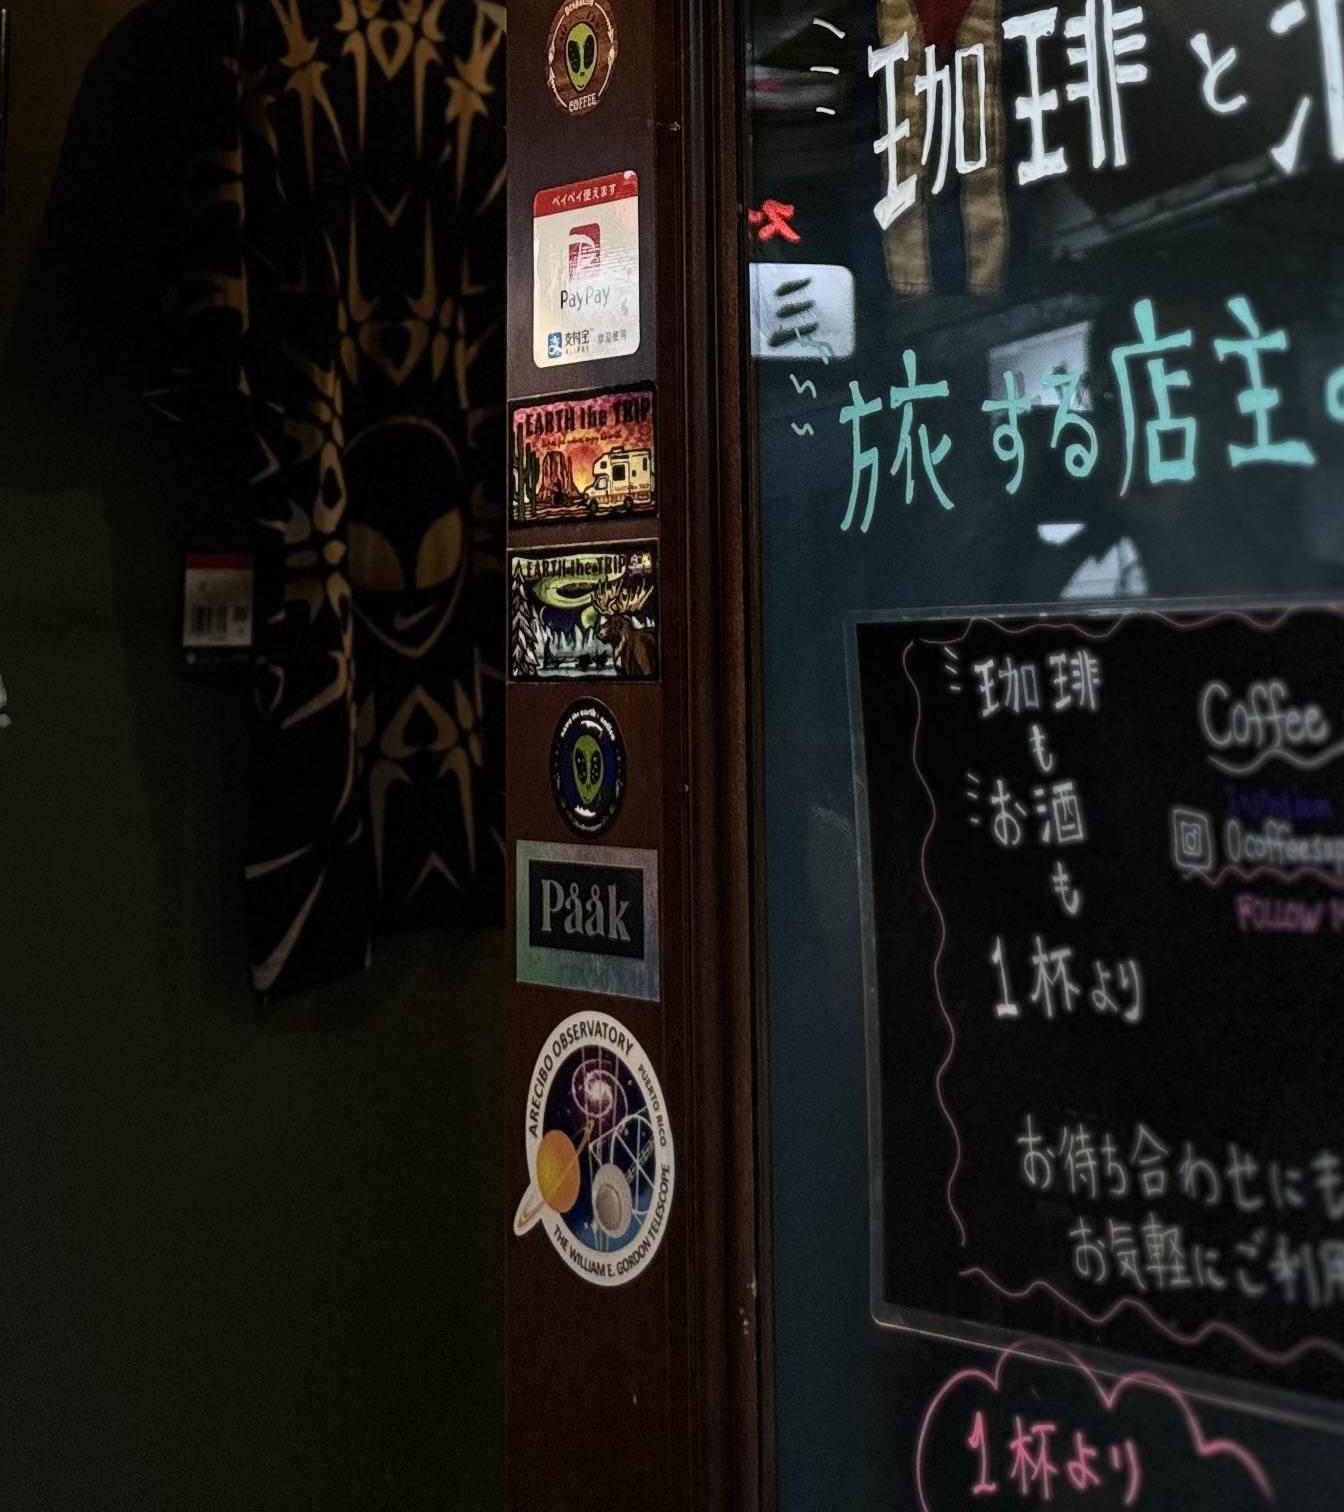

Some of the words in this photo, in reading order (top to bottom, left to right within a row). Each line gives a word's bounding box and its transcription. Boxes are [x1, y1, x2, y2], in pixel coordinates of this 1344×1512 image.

[568, 92, 598, 114] COFFEE
[560, 285, 610, 310] PayPay
[525, 405, 576, 438] EARTH
[580, 404, 606, 430] the
[613, 396, 651, 426] TRIP
[526, 557, 566, 579] EARTH
[597, 553, 627, 577] TRIP
[973, 649, 1102, 718] 珈琲
[1200, 679, 1331, 749] Coffee
[1029, 724, 1054, 773] も
[991, 779, 1086, 846] お酒
[1052, 860, 1081, 916] も
[1236, 894, 1325, 934] FOLLOW
[990, 934, 1143, 1024] 1杯より
[528, 1053, 555, 1138] ARECIBO
[552, 1019, 635, 1058] OBSERVATORY
[636, 1062, 661, 1114] PUERTO
[656, 1115, 667, 1148] RICO
[553, 1223, 570, 1252] THE
[568, 1248, 606, 1277] WILLIAM
[617, 1238, 653, 1276] GORDON
[647, 1164, 670, 1242] TELESCOPE
[967, 1410, 1143, 1506] 1杯より
